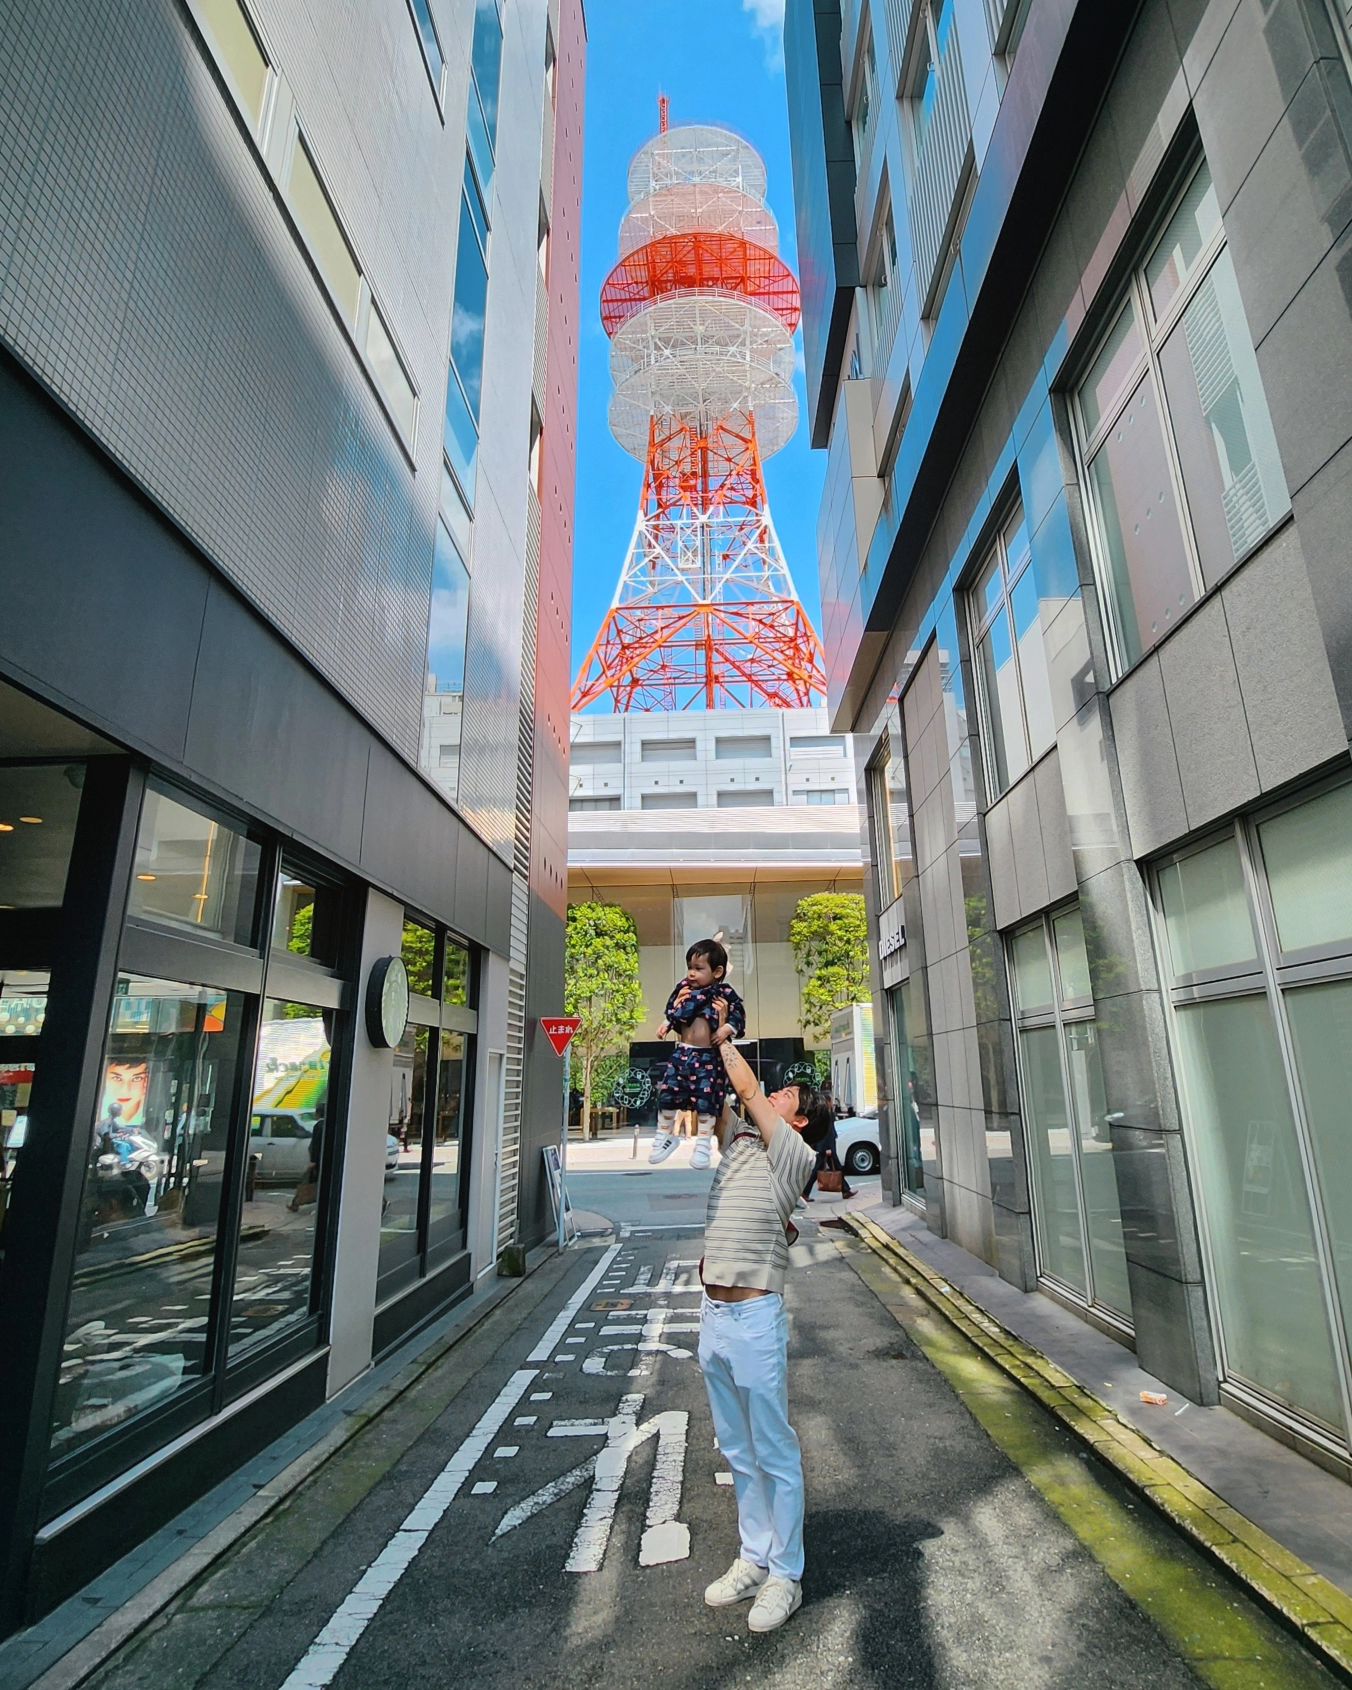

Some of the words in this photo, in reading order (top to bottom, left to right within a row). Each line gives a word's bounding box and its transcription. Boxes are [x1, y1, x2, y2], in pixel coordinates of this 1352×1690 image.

[879, 924, 906, 960] DIESEL
[549, 1024, 574, 1035] 止まれ
